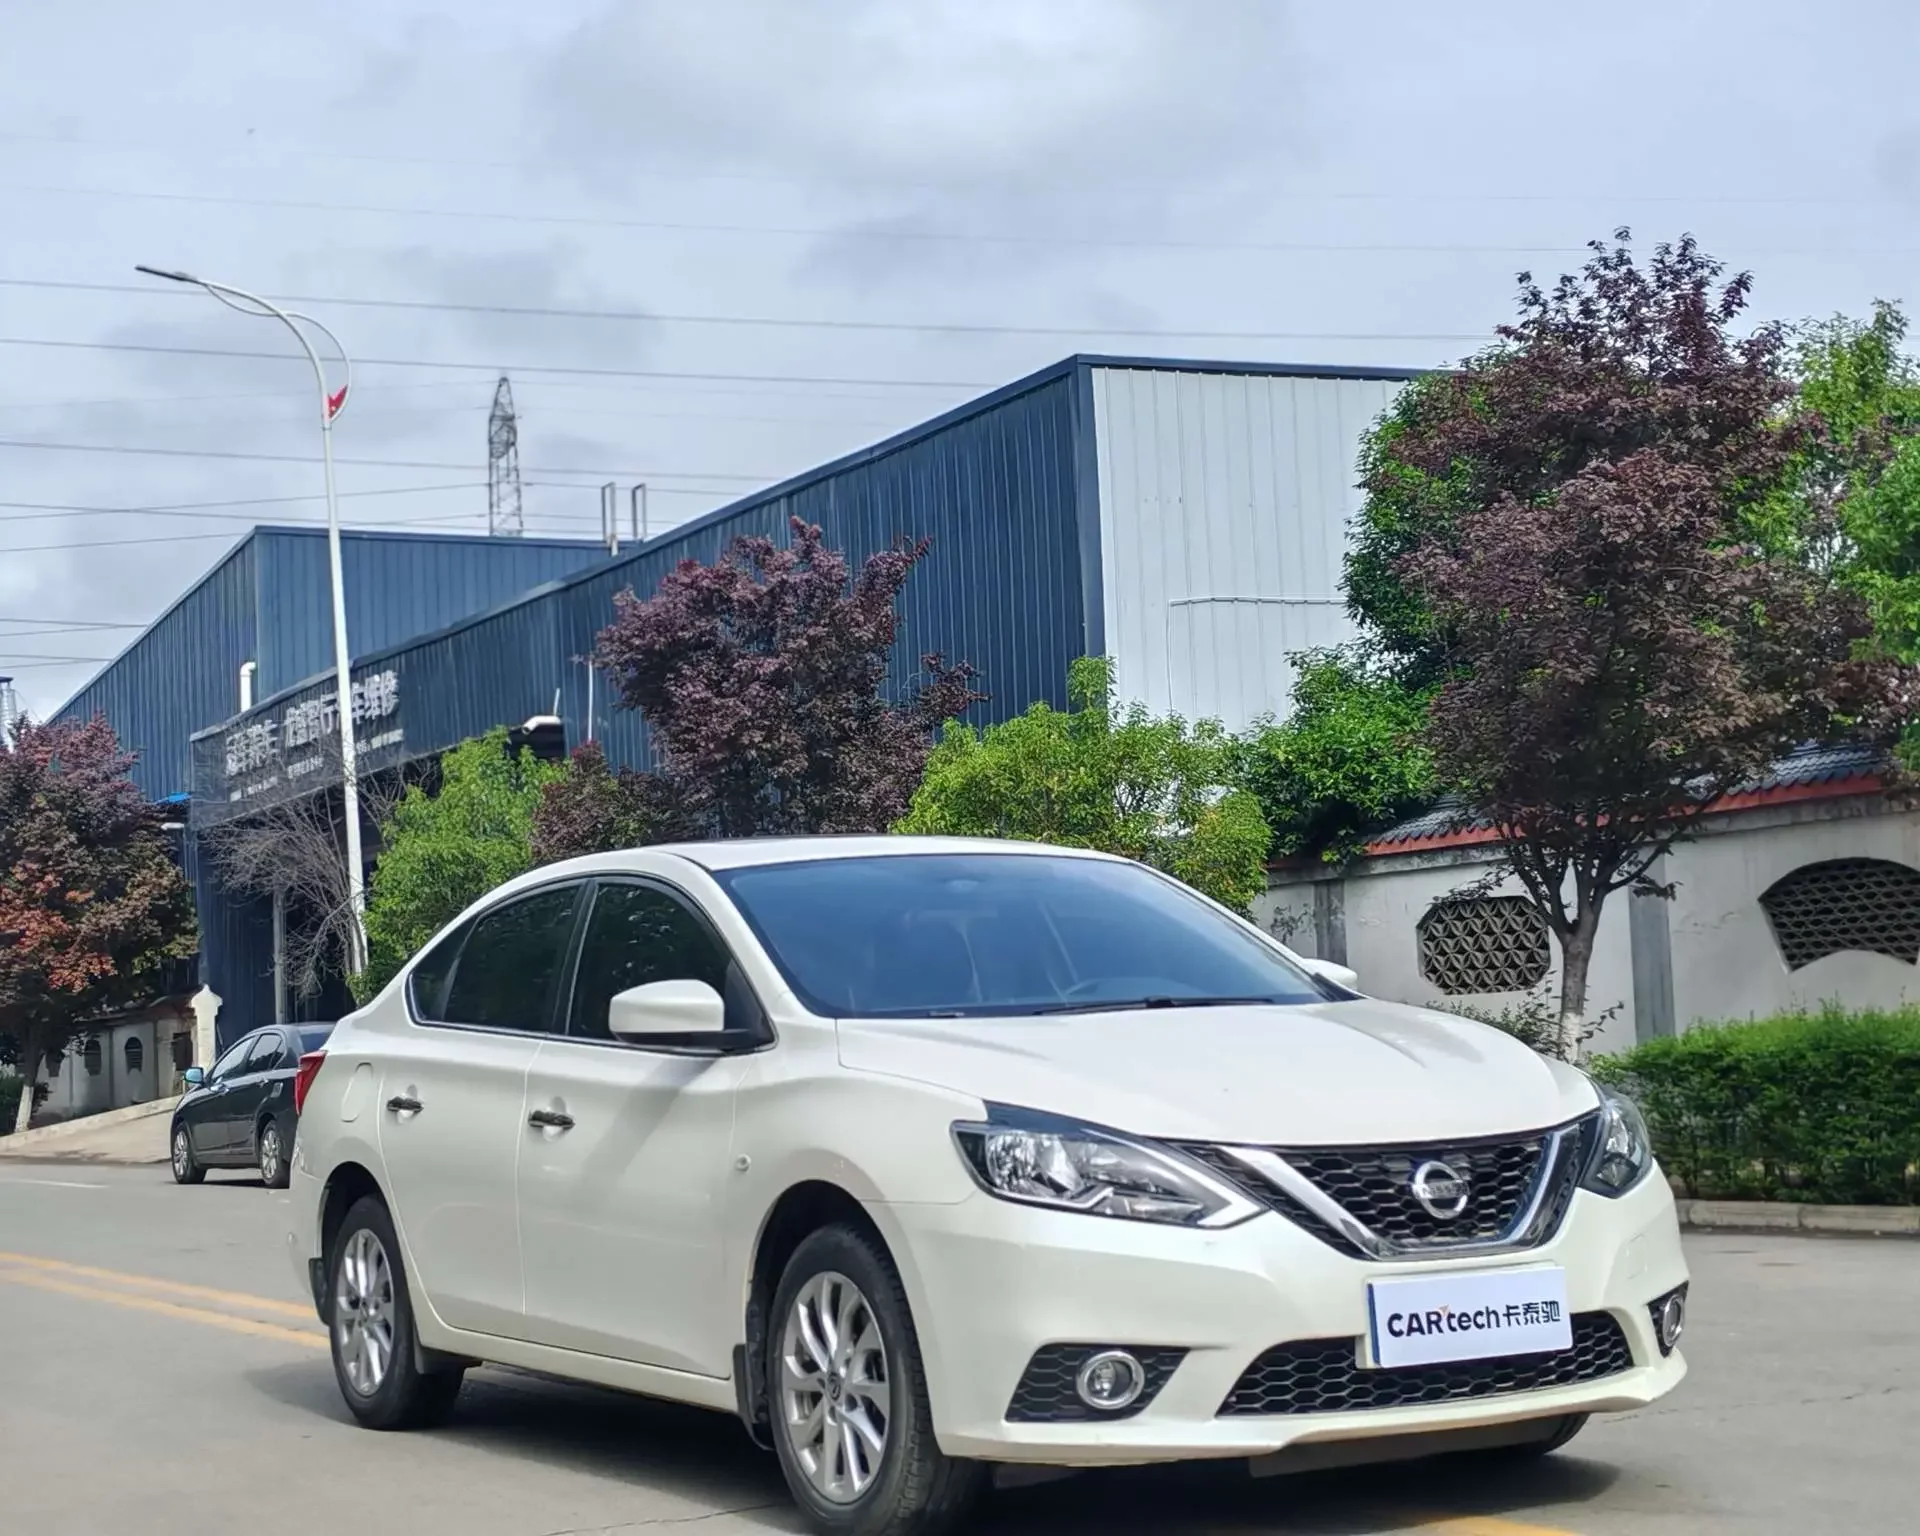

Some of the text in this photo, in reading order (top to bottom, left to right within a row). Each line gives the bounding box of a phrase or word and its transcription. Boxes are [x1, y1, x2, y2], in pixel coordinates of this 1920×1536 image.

[1387, 1300, 1560, 1337] CARtech 卡泰驰
